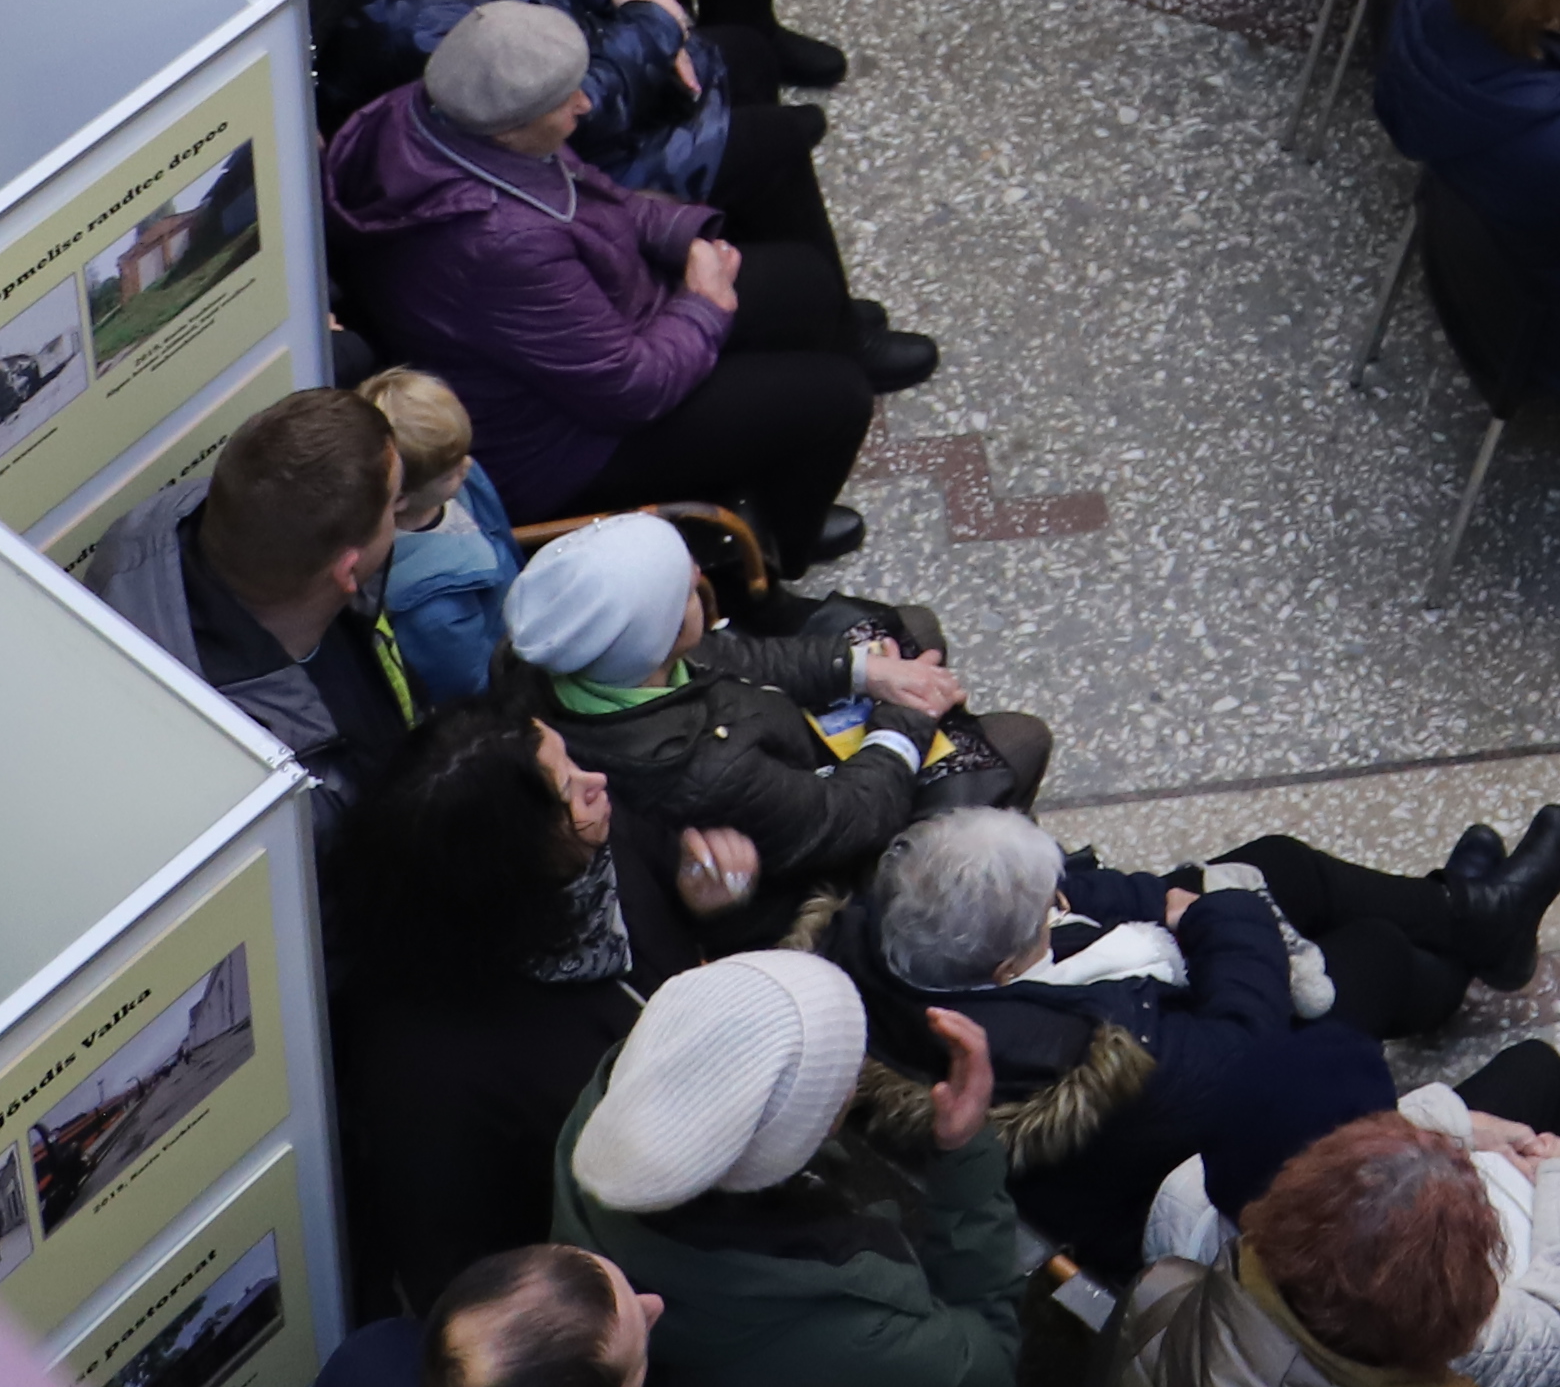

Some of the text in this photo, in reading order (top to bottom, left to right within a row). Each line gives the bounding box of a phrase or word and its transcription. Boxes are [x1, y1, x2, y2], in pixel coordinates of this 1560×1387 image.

[86, 167, 166, 234] raudtee
[168, 120, 229, 174] depoo
[80, 984, 154, 1049] Valka
[103, 1247, 219, 1365] pastoraat
